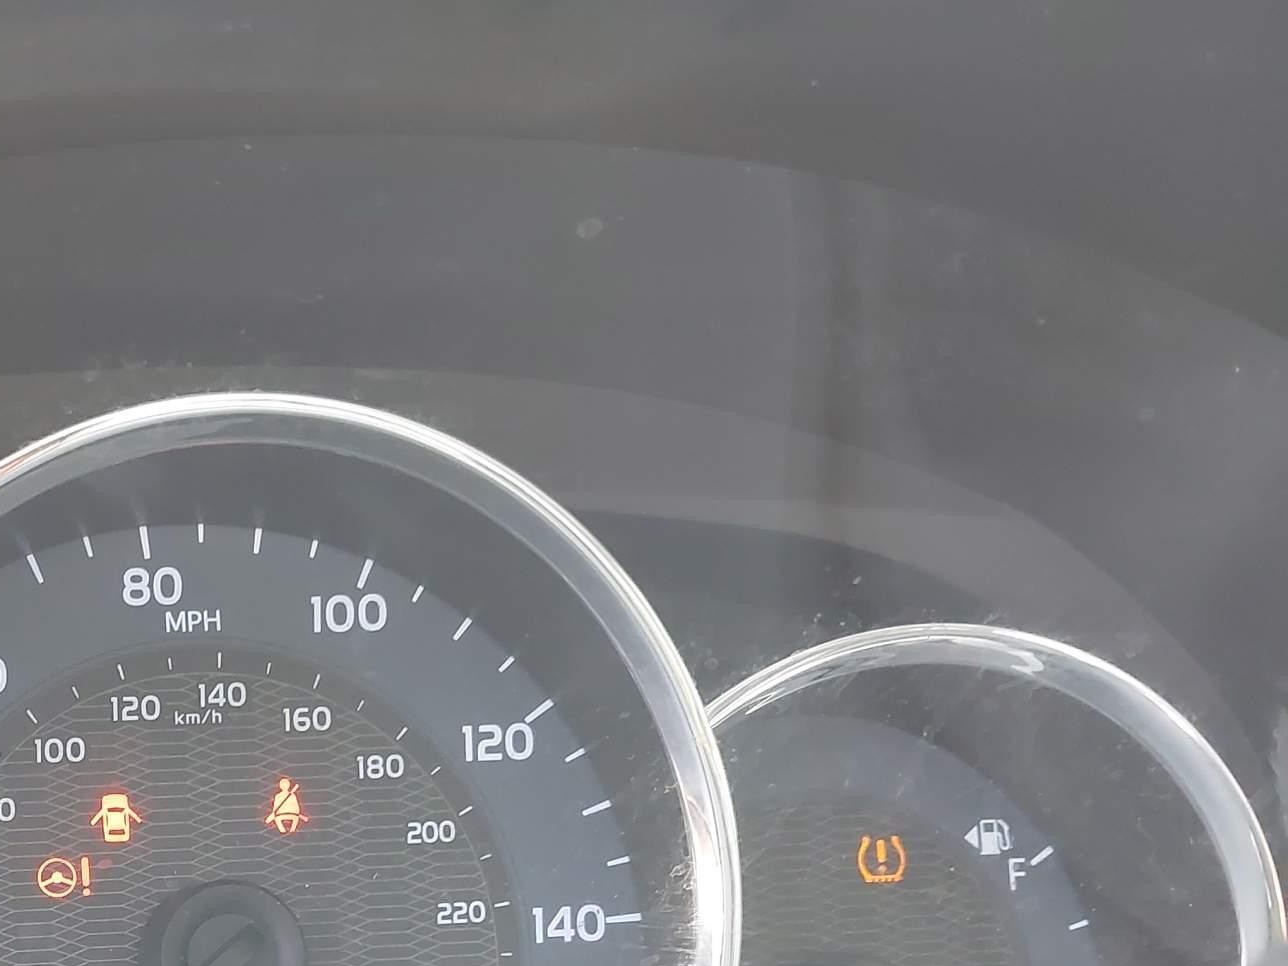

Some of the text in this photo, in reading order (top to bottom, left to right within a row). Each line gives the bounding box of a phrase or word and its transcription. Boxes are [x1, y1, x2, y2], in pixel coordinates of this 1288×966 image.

[122, 566, 183, 605] 80
[164, 609, 222, 633] MPH
[310, 594, 387, 634] 100
[197, 682, 246, 708] 140
[110, 695, 161, 723] 120
[174, 710, 222, 726] km/h
[283, 706, 331, 731] 160
[33, 737, 85, 763] 100
[461, 722, 534, 762] 120
[356, 754, 404, 779] 180
[407, 820, 456, 845] 200
[1008, 857, 1026, 891] F
[436, 900, 485, 925] 220
[532, 904, 605, 943] 140
